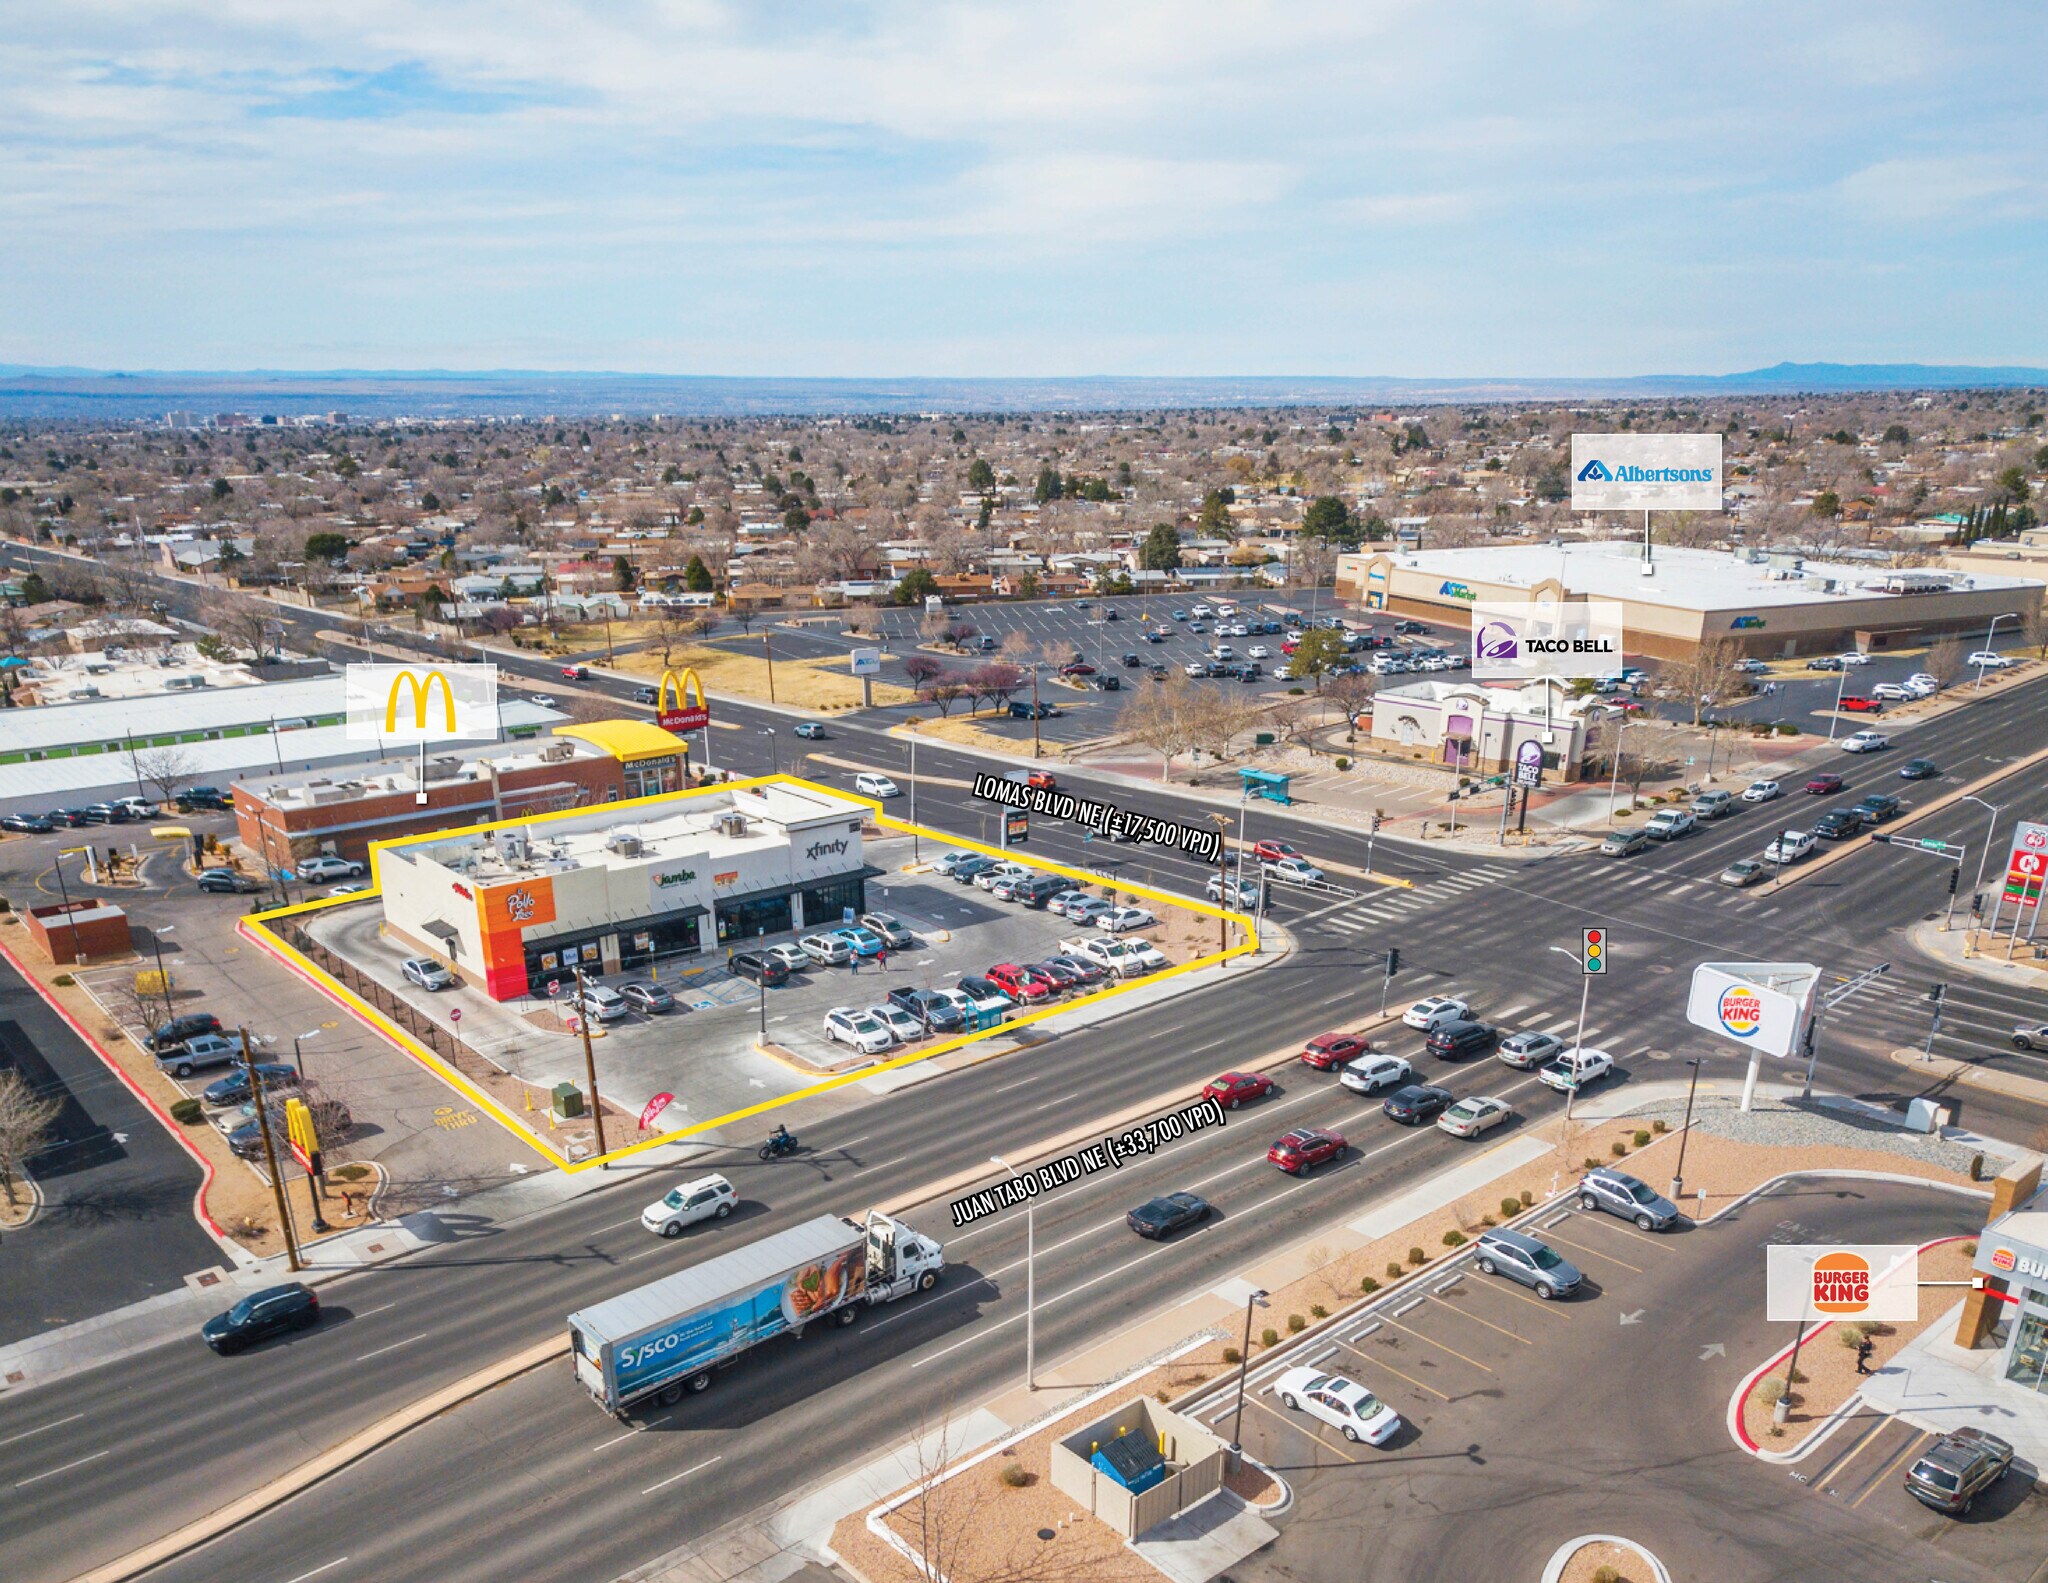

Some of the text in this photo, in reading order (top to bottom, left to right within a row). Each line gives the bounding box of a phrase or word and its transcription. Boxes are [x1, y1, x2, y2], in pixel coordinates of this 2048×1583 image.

[662, 713, 708, 726] McDonald's
[624, 755, 677, 769] McDonald's
[805, 838, 850, 861] xfinity
[660, 869, 697, 886] jamba
[507, 892, 535, 914] Pollo
[512, 910, 535, 922] Loco
[1722, 997, 1761, 1008] BURGER
[1721, 1008, 1761, 1022] KING
